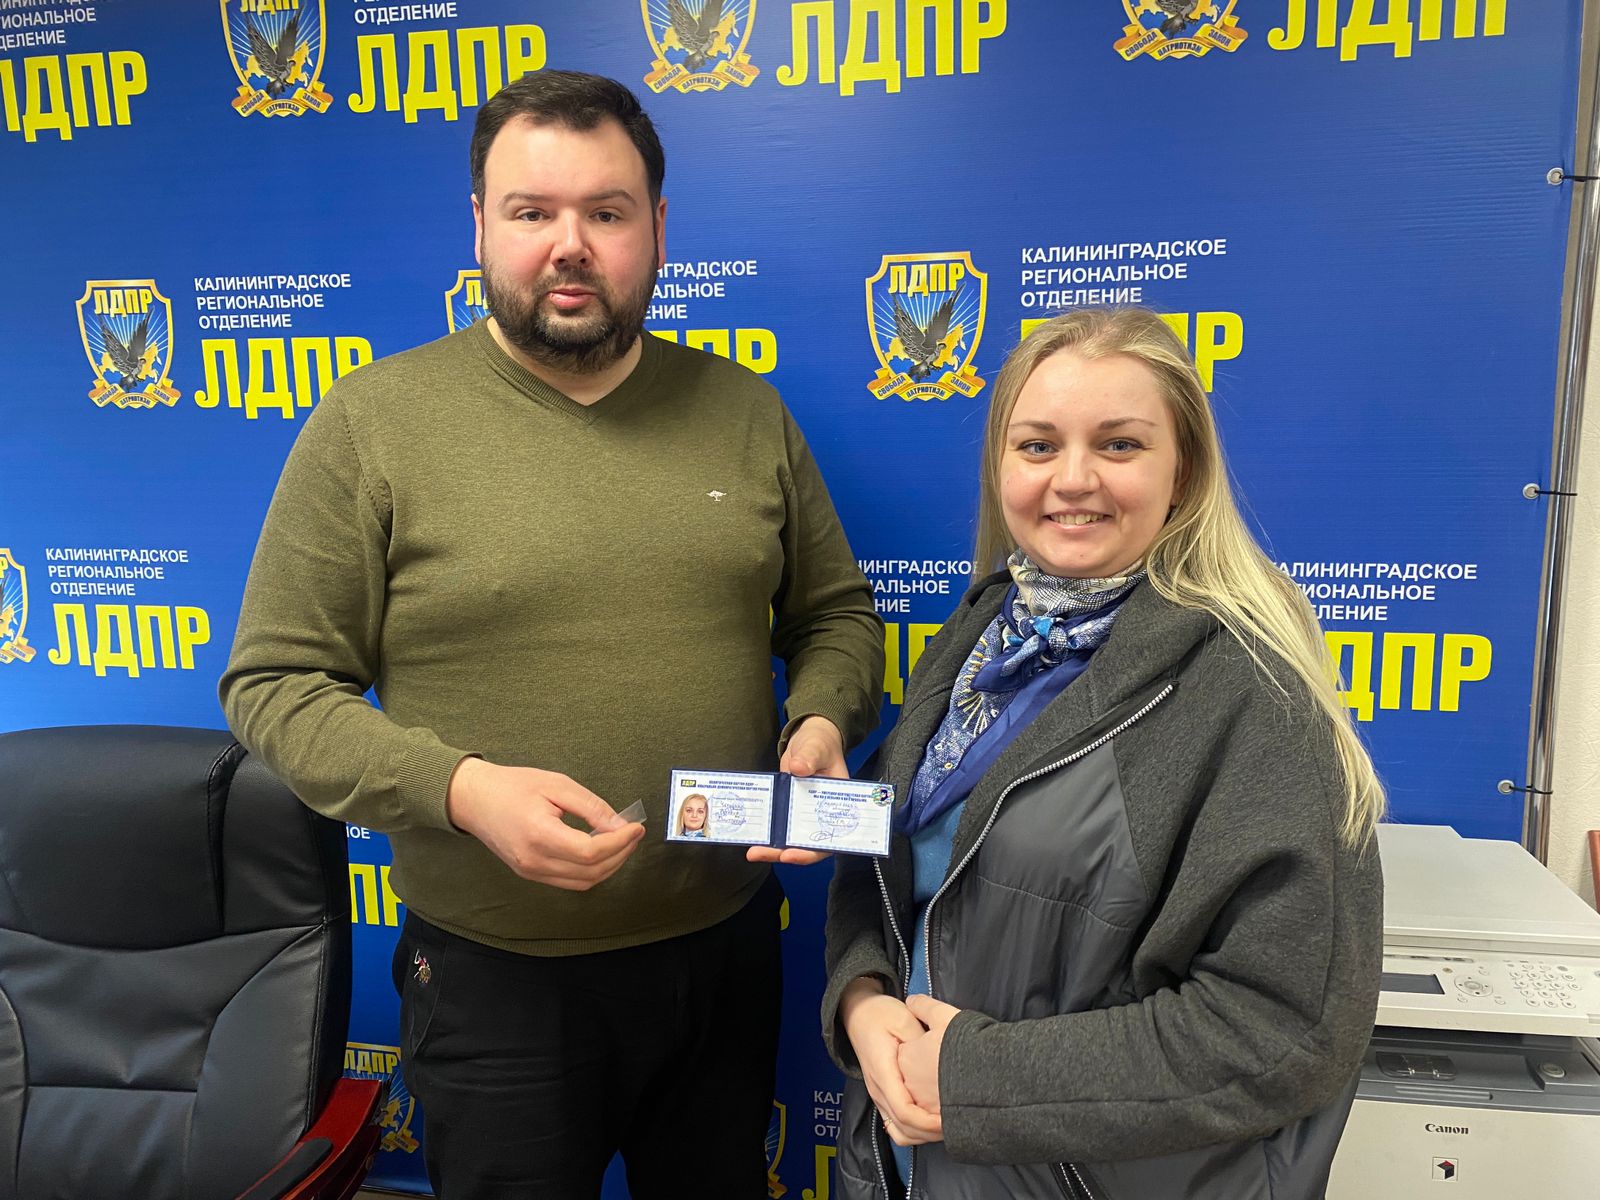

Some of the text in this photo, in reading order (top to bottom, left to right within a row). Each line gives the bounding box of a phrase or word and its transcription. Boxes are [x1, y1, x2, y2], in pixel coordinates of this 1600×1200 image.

[0, 7, 97, 29] ИОНАЛЬНОЕ
[354, 2, 458, 25] ОТДЕЛЕНИЕ
[776, 0, 1008, 97] ЛДПР
[1124, 31, 1158, 57] СВОБОДА
[1208, 29, 1232, 47] ЗАКОН
[348, 24, 547, 124] ЛДПР
[1021, 238, 1228, 264] КАЛИНИНГРАДСКОЕ
[194, 273, 352, 292] КАЛИНИНГРАДСКОЕ
[887, 262, 966, 298] ЛДПР
[1021, 262, 1188, 286] РЕГИОНАЛЬНОЕ
[93, 288, 153, 318] ЛДПР
[196, 293, 325, 311] РЕГИОНАЛЬНОЕ
[1020, 286, 1143, 309] ОТДЕЛЕНИЕ
[198, 313, 293, 331] ОТДЕЛЕНИЕ
[194, 336, 373, 420] ЛДПР
[877, 374, 906, 398] СВОБОДА
[950, 375, 972, 393] ЗАКОН
[45, 548, 189, 563] КАЛИНИНГРАДСКОЕ
[48, 565, 165, 580] РЕГИОНАЛЬНОЕ
[1274, 562, 1478, 581] АЛИНИНГРАДСКОЕ
[50, 581, 136, 597] ОТДЕЛЕНИЕ
[870, 579, 950, 594] АЛЬНОЕ
[1297, 583, 1436, 601] ИОНАЛЬНОЕ
[48, 603, 211, 678] ЛДПР
[344, 1049, 398, 1075] ЛДПР
[1424, 1123, 1469, 1135] Canon
